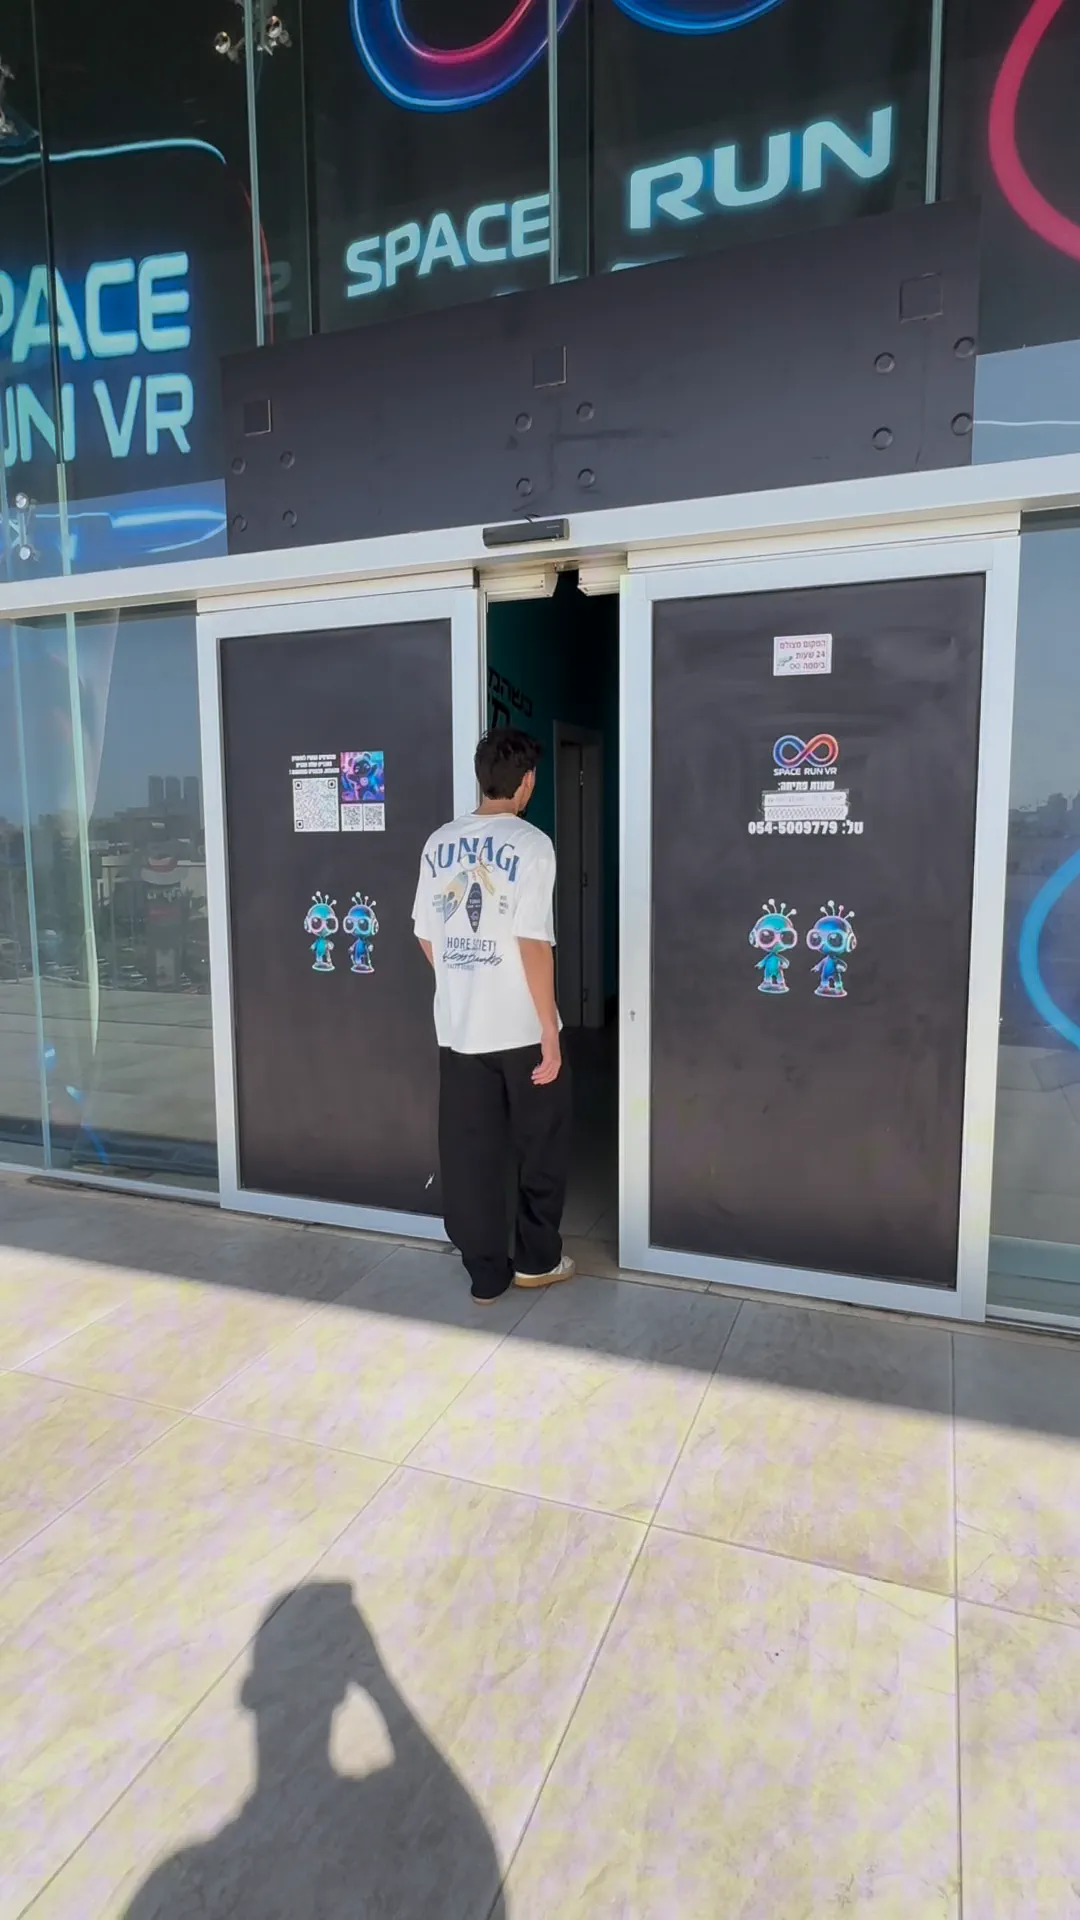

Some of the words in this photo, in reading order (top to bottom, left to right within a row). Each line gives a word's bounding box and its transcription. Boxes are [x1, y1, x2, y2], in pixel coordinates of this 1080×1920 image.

[346, 192, 550, 298] SPACE
[629, 105, 893, 230] RUN
[93, 373, 194, 458] VR
[795, 651, 815, 660] שעות
[773, 768, 801, 777] SPACE
[804, 767, 824, 776] RUN
[824, 766, 838, 775] VR
[810, 780, 835, 790] שעות
[748, 821, 838, 835] 054-5009779
[841, 819, 864, 834] טל:
[425, 836, 520, 882] YUNAGI
[447, 937, 471, 950] HORE
